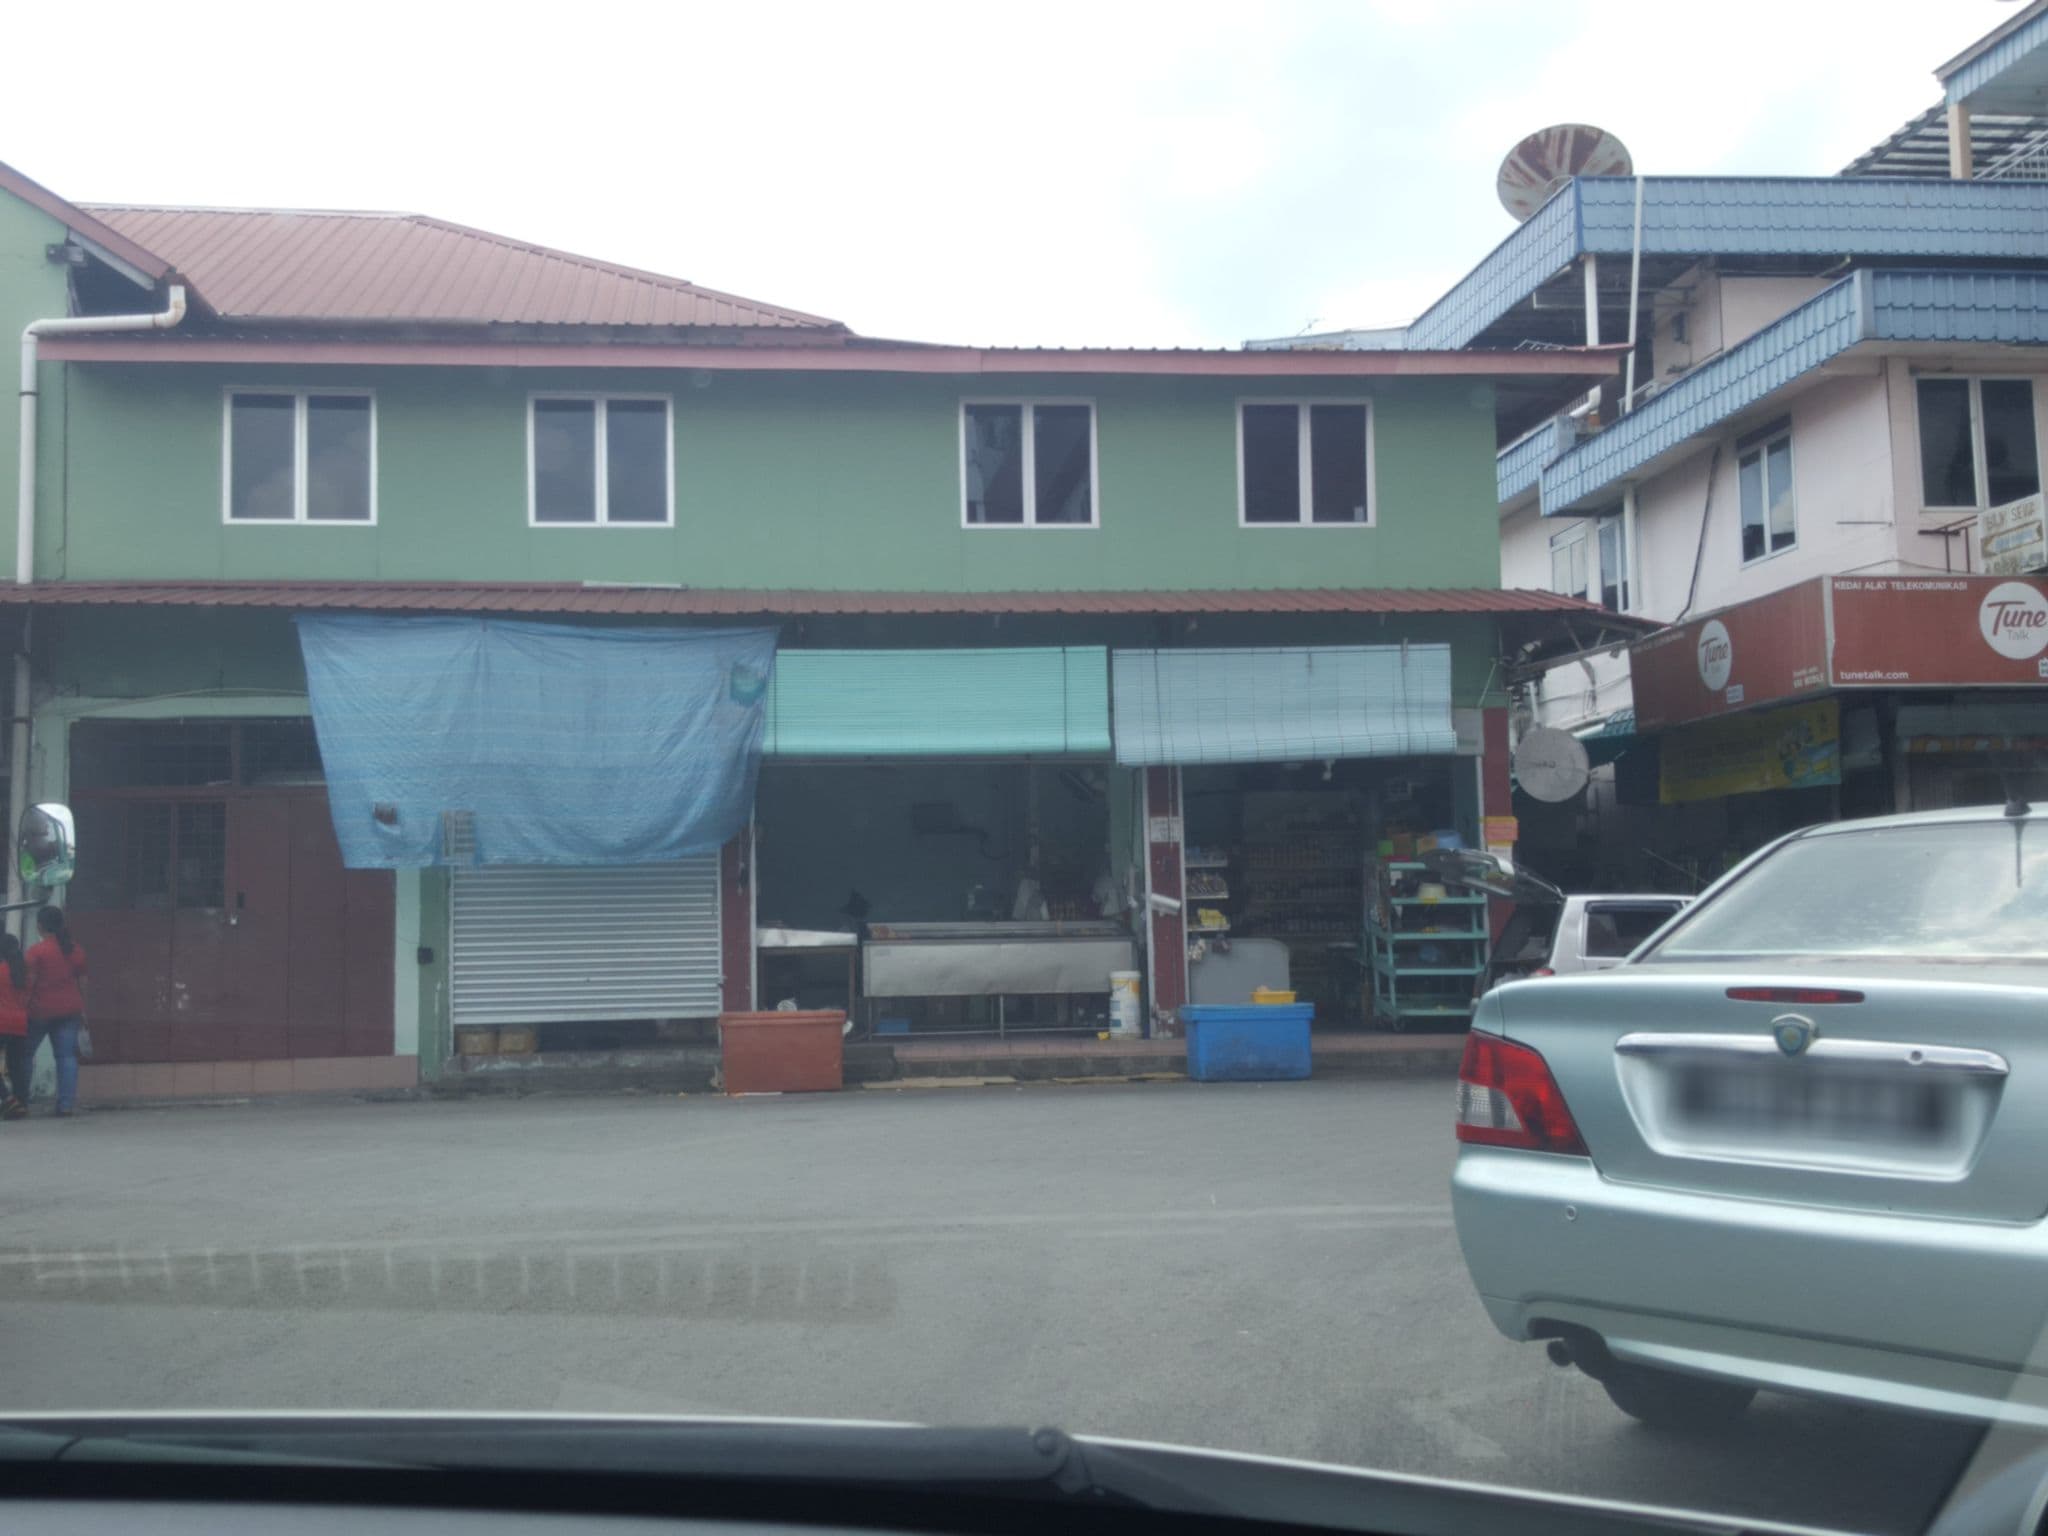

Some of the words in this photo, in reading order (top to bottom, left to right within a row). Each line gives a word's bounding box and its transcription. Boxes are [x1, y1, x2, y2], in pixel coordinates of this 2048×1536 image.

[1865, 581, 1887, 590] ALAT
[1987, 600, 2047, 636] Tune
[2007, 629, 2030, 641] Talk
[1701, 637, 1728, 672] Tune
[1840, 671, 1909, 680] tunetalk.com
